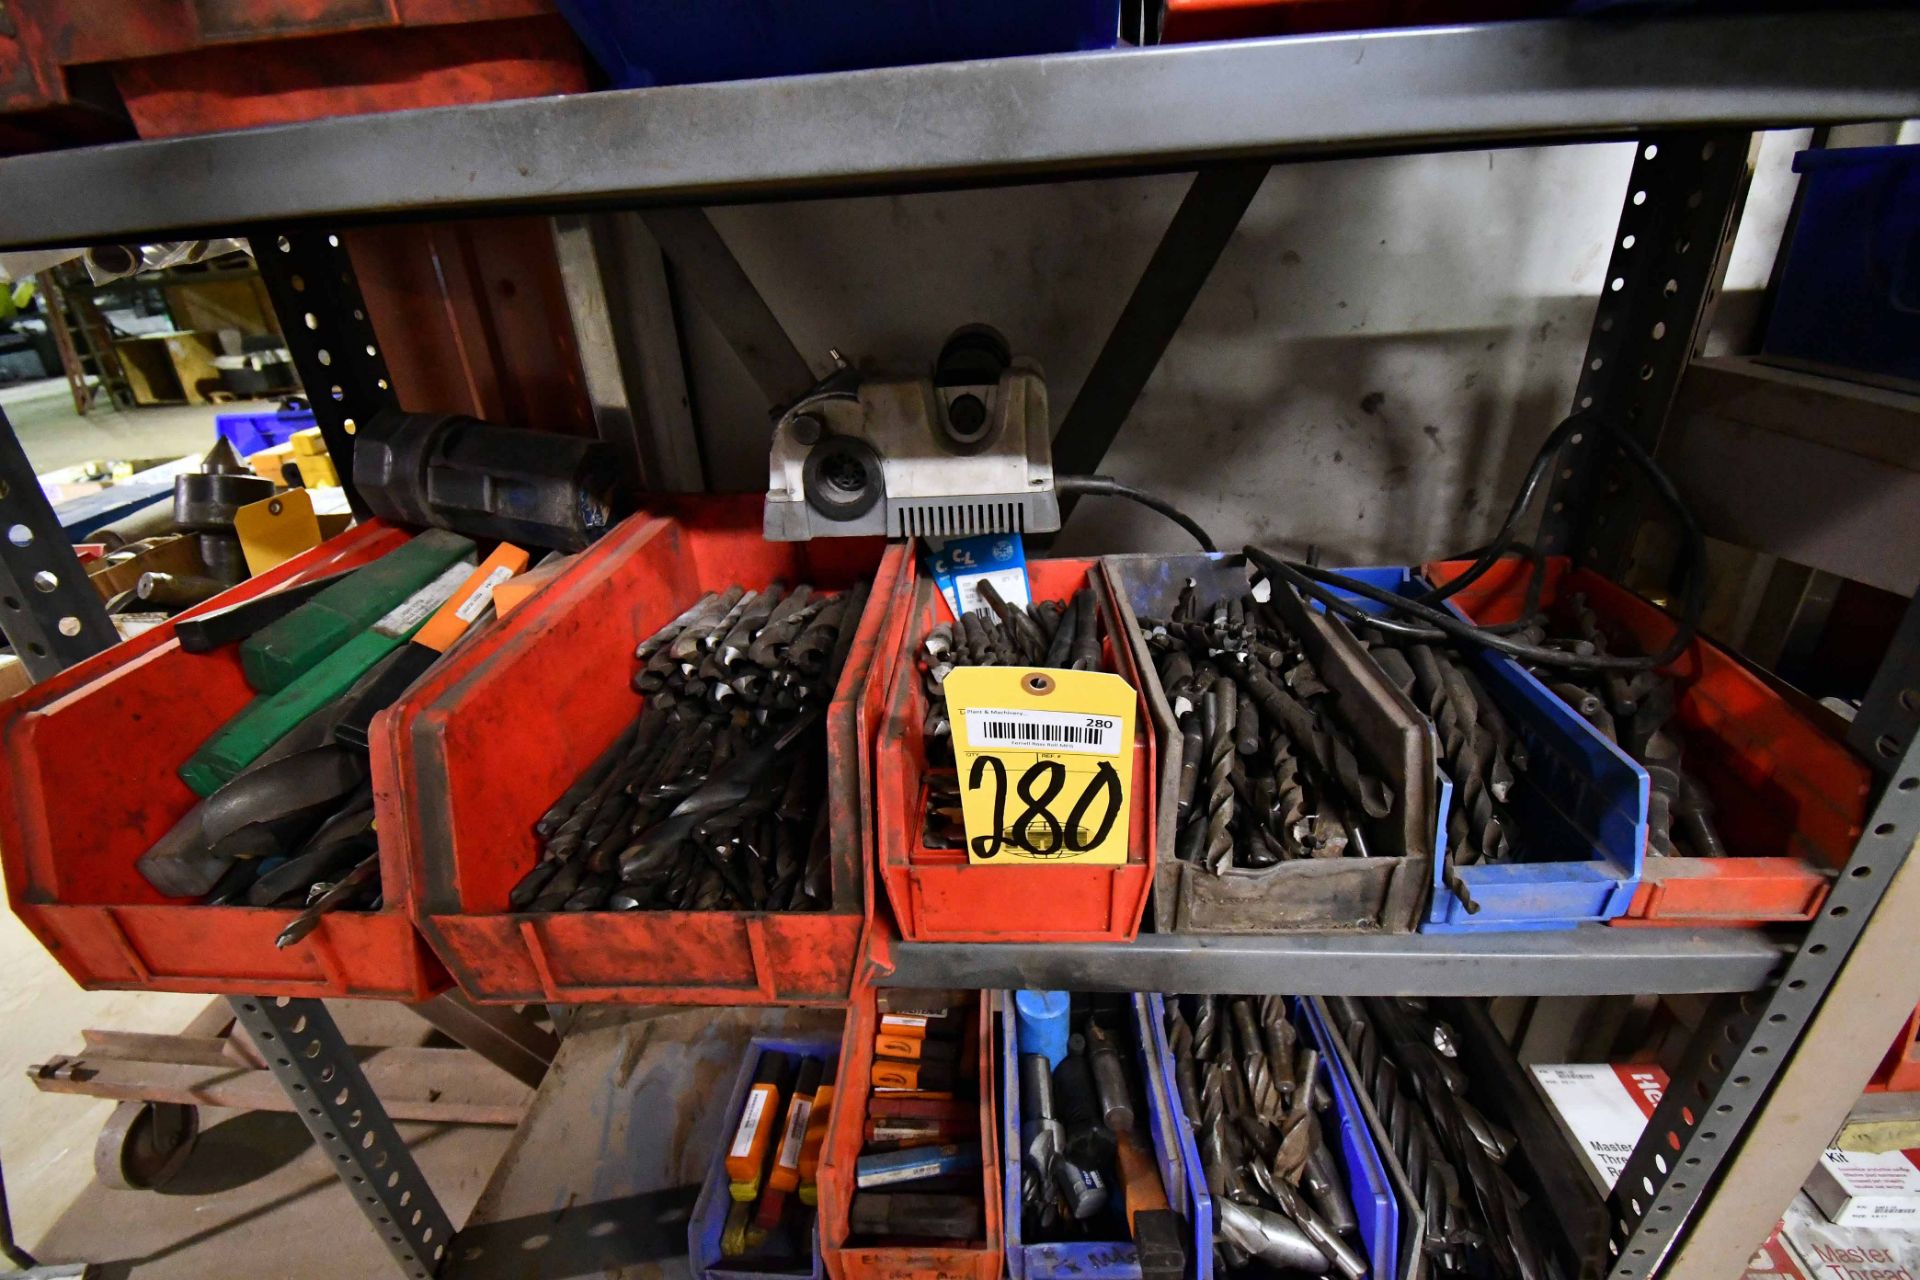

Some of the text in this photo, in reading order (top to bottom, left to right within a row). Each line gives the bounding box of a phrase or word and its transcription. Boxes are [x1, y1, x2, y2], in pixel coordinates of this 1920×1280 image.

[1086, 718, 1113, 729] 280
[969, 755, 1123, 859] 280
[1589, 1141, 1633, 1152] Master
[1825, 1153, 1849, 1163] Kit
[1811, 1243, 1894, 1263] Master
